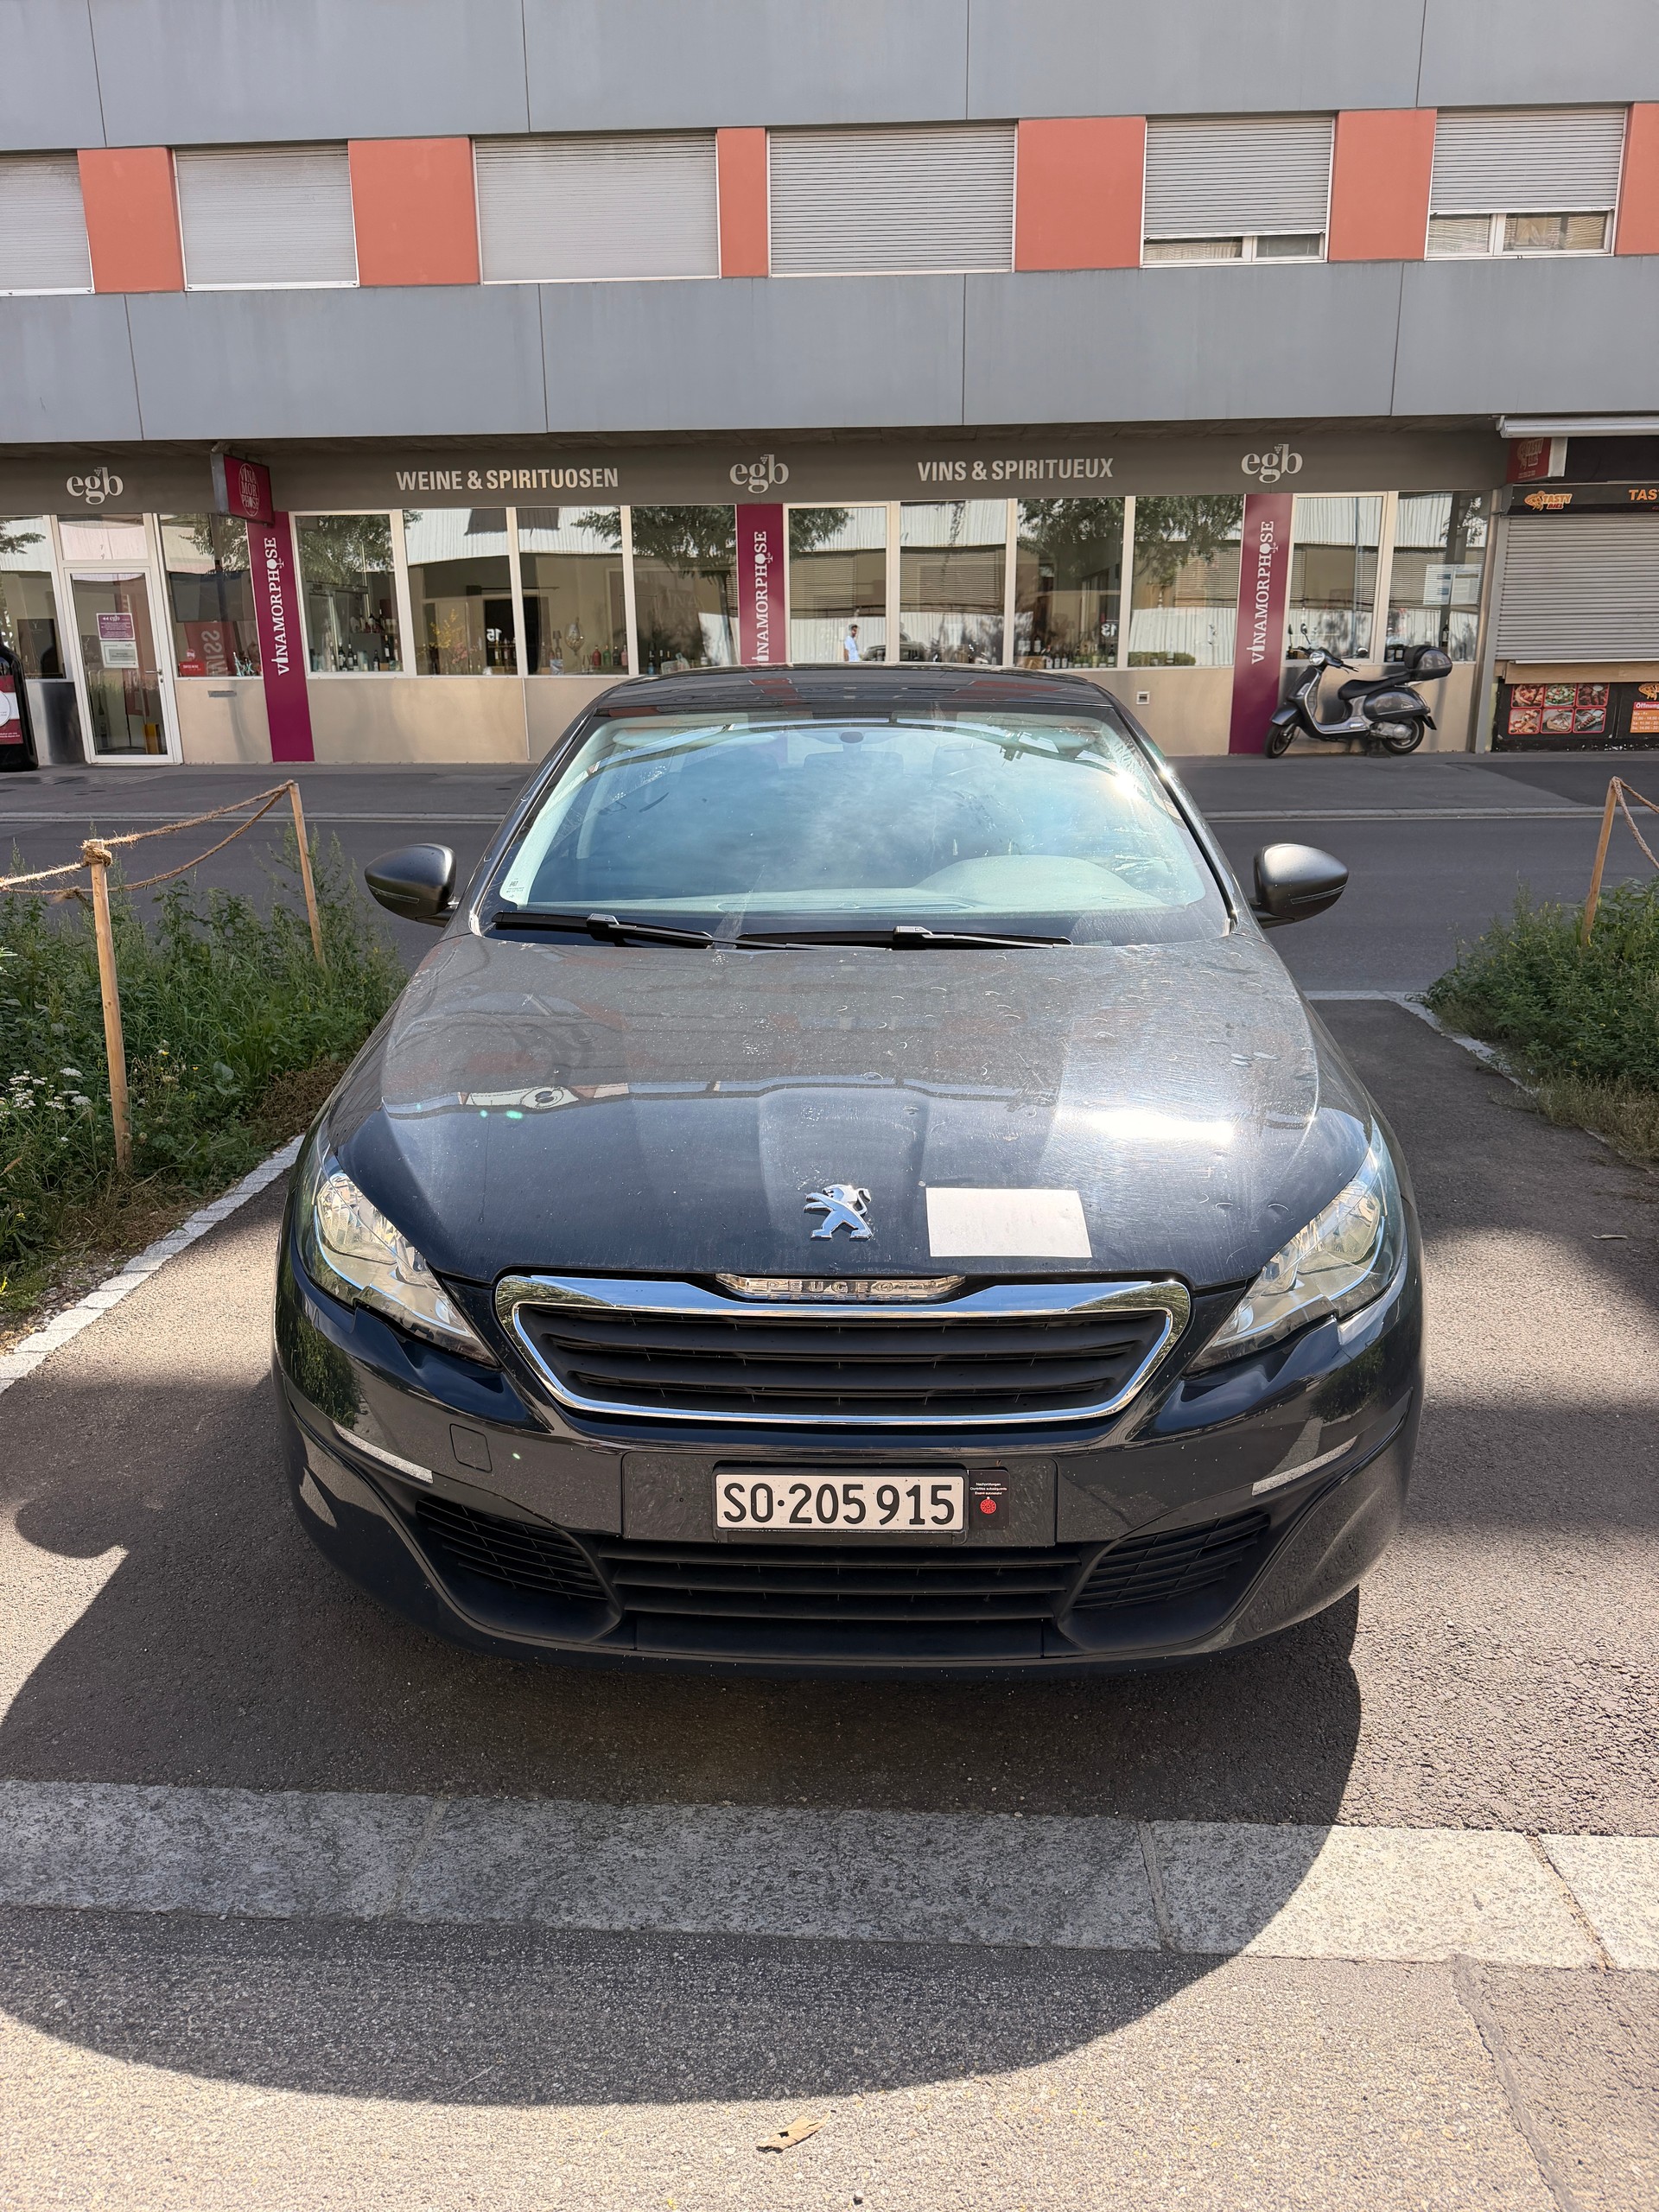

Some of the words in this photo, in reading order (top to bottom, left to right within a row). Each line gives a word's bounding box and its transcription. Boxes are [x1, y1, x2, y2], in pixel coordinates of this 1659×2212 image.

[729, 454, 790, 493] egb
[918, 461, 967, 481] VINS
[971, 460, 988, 480] &
[991, 458, 1114, 480] SPIRITUEUX
[1241, 443, 1303, 484] egb
[67, 467, 124, 505] egb
[241, 481, 257, 497] MOR
[396, 471, 463, 491] WEINE
[467, 470, 483, 489] &
[486, 468, 618, 489] SPIRITUOSEN
[1542, 493, 1573, 504] TASTY
[1628, 488, 1659, 501] TAS
[752, 531, 773, 664] INAMORPHOSE
